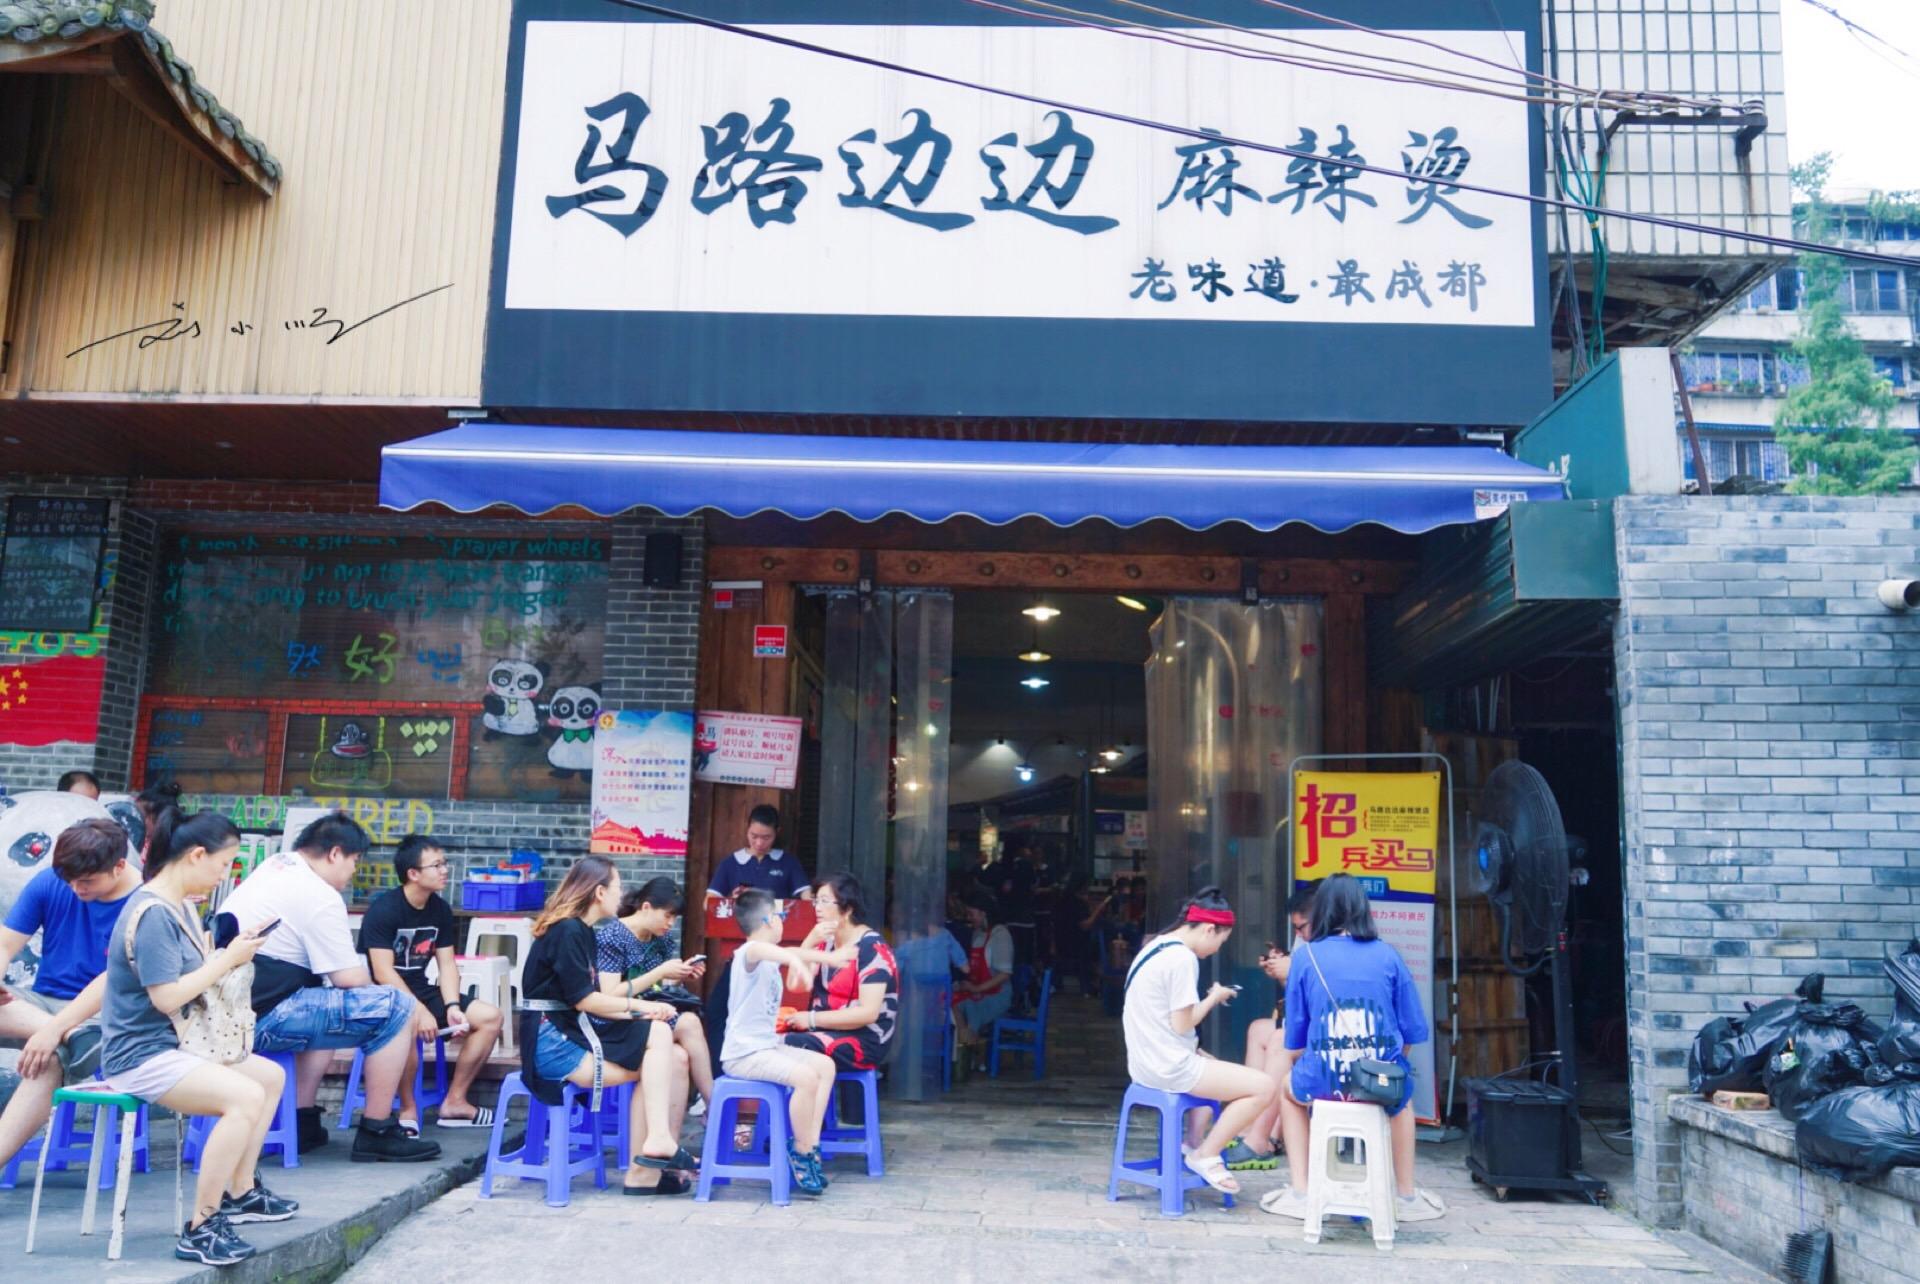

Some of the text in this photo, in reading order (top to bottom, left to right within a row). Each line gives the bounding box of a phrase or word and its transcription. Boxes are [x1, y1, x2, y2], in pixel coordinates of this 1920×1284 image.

[546, 92, 1493, 237] 马路边边 麻辣烫
[528, 534, 602, 559] wheels
[1299, 784, 1435, 872] 招 兵买马
